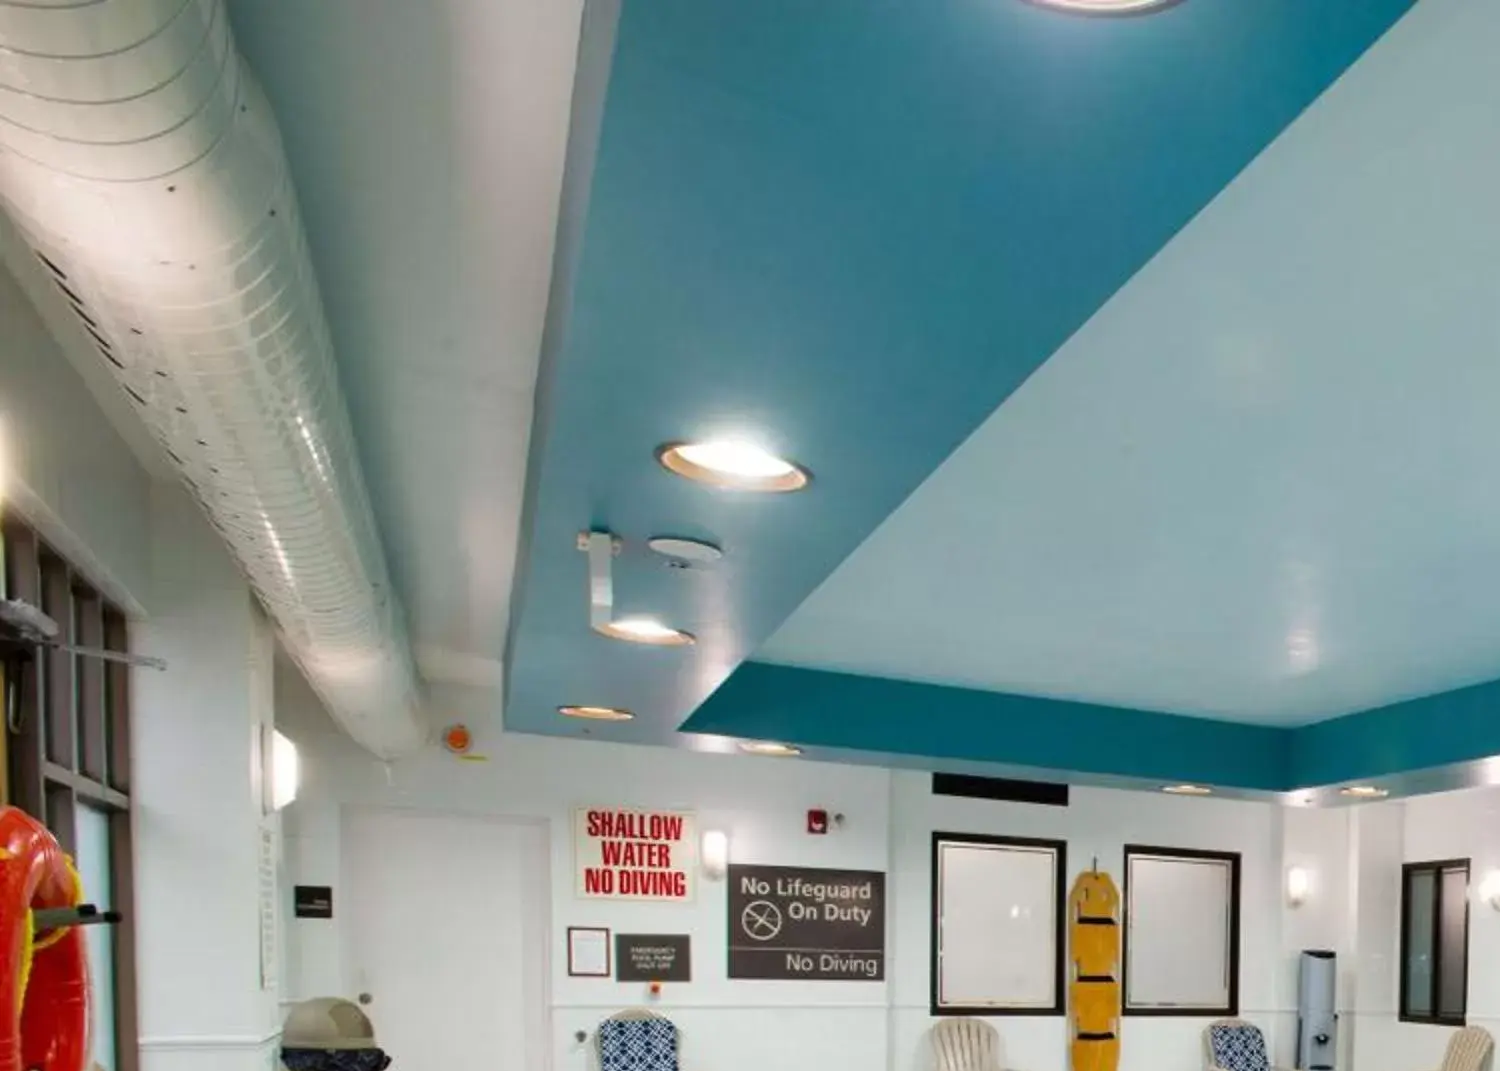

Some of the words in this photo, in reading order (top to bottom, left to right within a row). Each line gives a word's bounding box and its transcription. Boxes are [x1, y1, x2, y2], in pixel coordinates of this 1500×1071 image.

[587, 810, 683, 841] SHALLOW
[601, 840, 670, 868] WATER
[585, 868, 613, 894] NO
[619, 869, 686, 897] DIVING
[741, 876, 771, 895] No
[777, 878, 872, 902] Lifeguard
[788, 902, 818, 920] On
[823, 903, 872, 927] Duty
[786, 953, 814, 971] No
[820, 953, 877, 977] Diving
